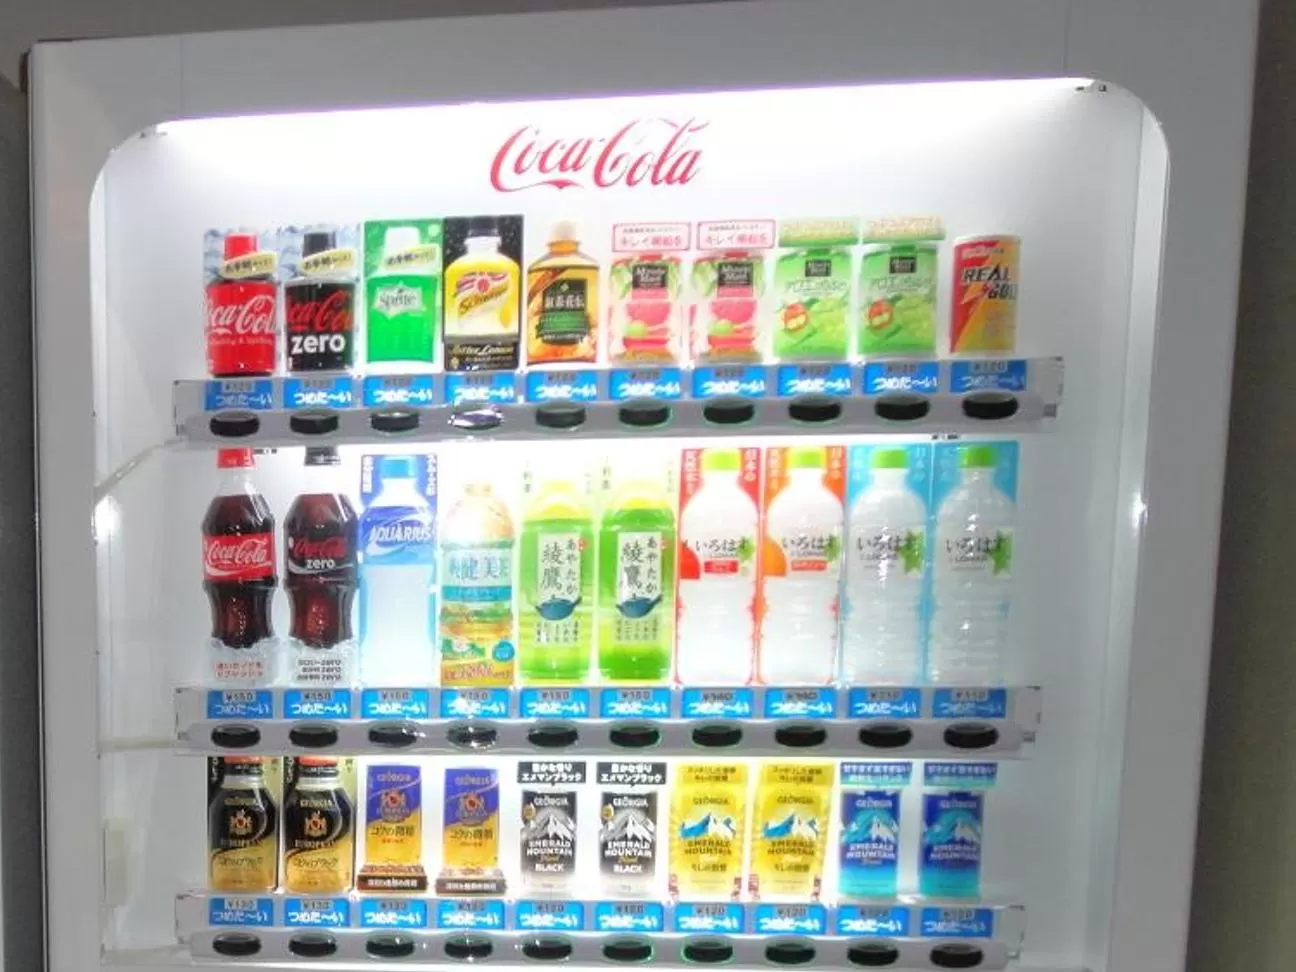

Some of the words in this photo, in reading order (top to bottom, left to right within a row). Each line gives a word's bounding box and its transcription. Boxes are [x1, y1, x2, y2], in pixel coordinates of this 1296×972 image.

[489, 116, 711, 193] Coca-Cola
[962, 265, 1012, 282] REAL
[290, 333, 347, 354] zero
[367, 524, 433, 543] AQUARIUS
[306, 558, 336, 570] zero
[535, 863, 565, 872] BLACK
[613, 864, 642, 873] BLACK
